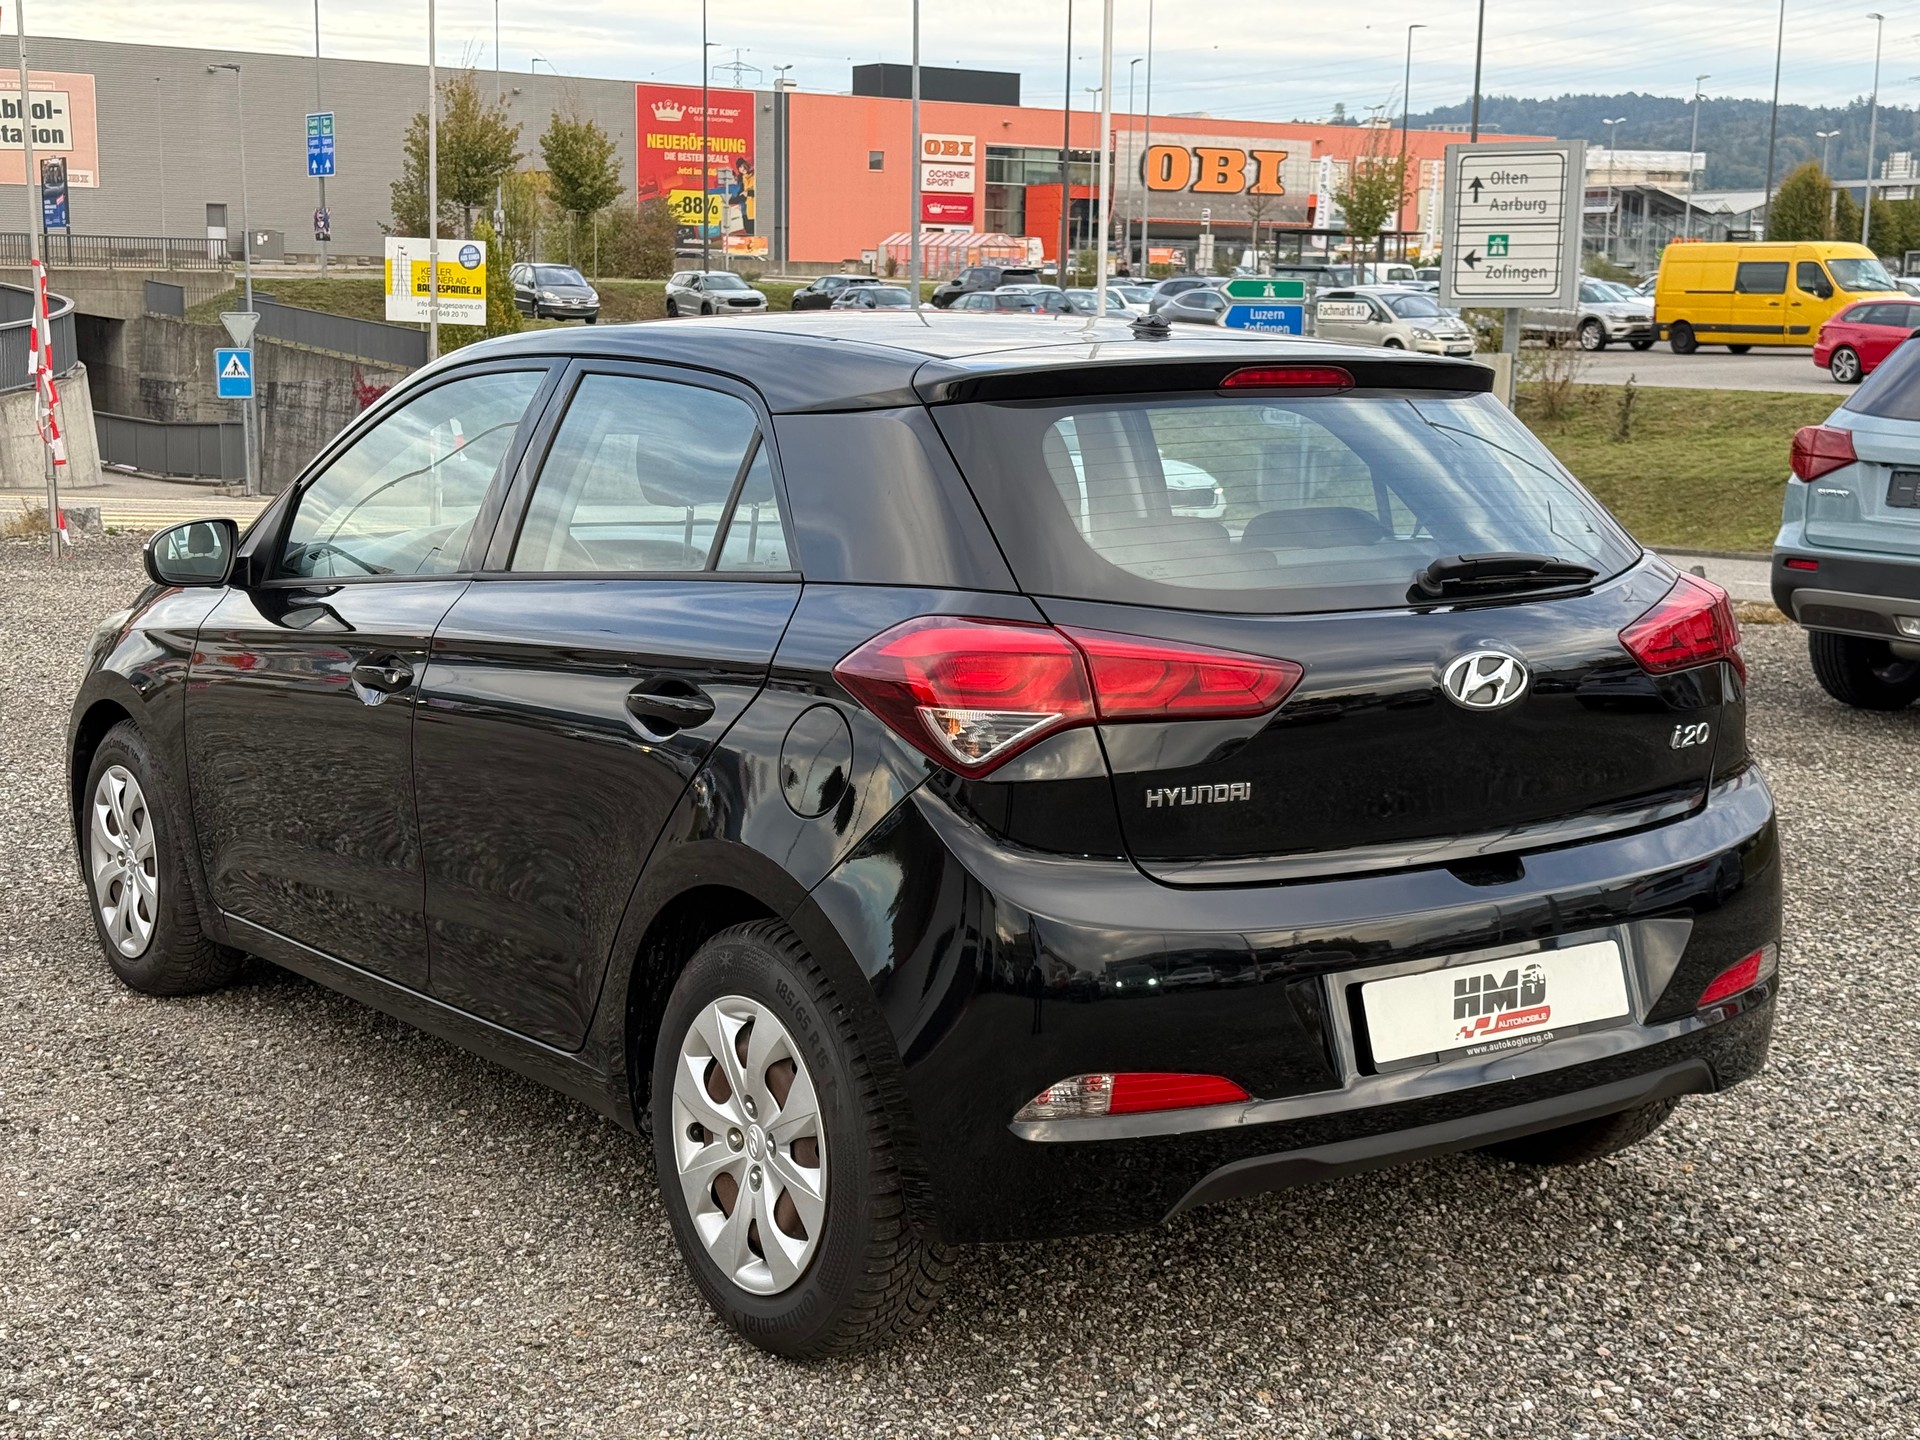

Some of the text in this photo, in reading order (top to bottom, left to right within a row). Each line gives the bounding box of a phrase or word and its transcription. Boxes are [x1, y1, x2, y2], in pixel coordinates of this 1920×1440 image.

[0, 125, 64, 143] taion
[664, 152, 676, 160] DIE
[924, 140, 973, 156] OBI
[928, 169, 970, 179] OCHSNER
[1141, 145, 1287, 195] OBI
[1490, 171, 1528, 185] Olten
[926, 177, 954, 187] SPORT
[1489, 197, 1547, 214] Aarburg
[455, 277, 467, 285] AG
[1485, 264, 1547, 282] Zofingen
[1250, 308, 1285, 320] Luzern
[1319, 304, 1365, 316] Fachmarkt A1
[1669, 722, 1710, 750] i20
[1146, 782, 1251, 808] HYUNDAI
[1498, 1012, 1547, 1028] AUTOMOBILE
[1467, 1031, 1554, 1056] www.autokoglerag.ch
